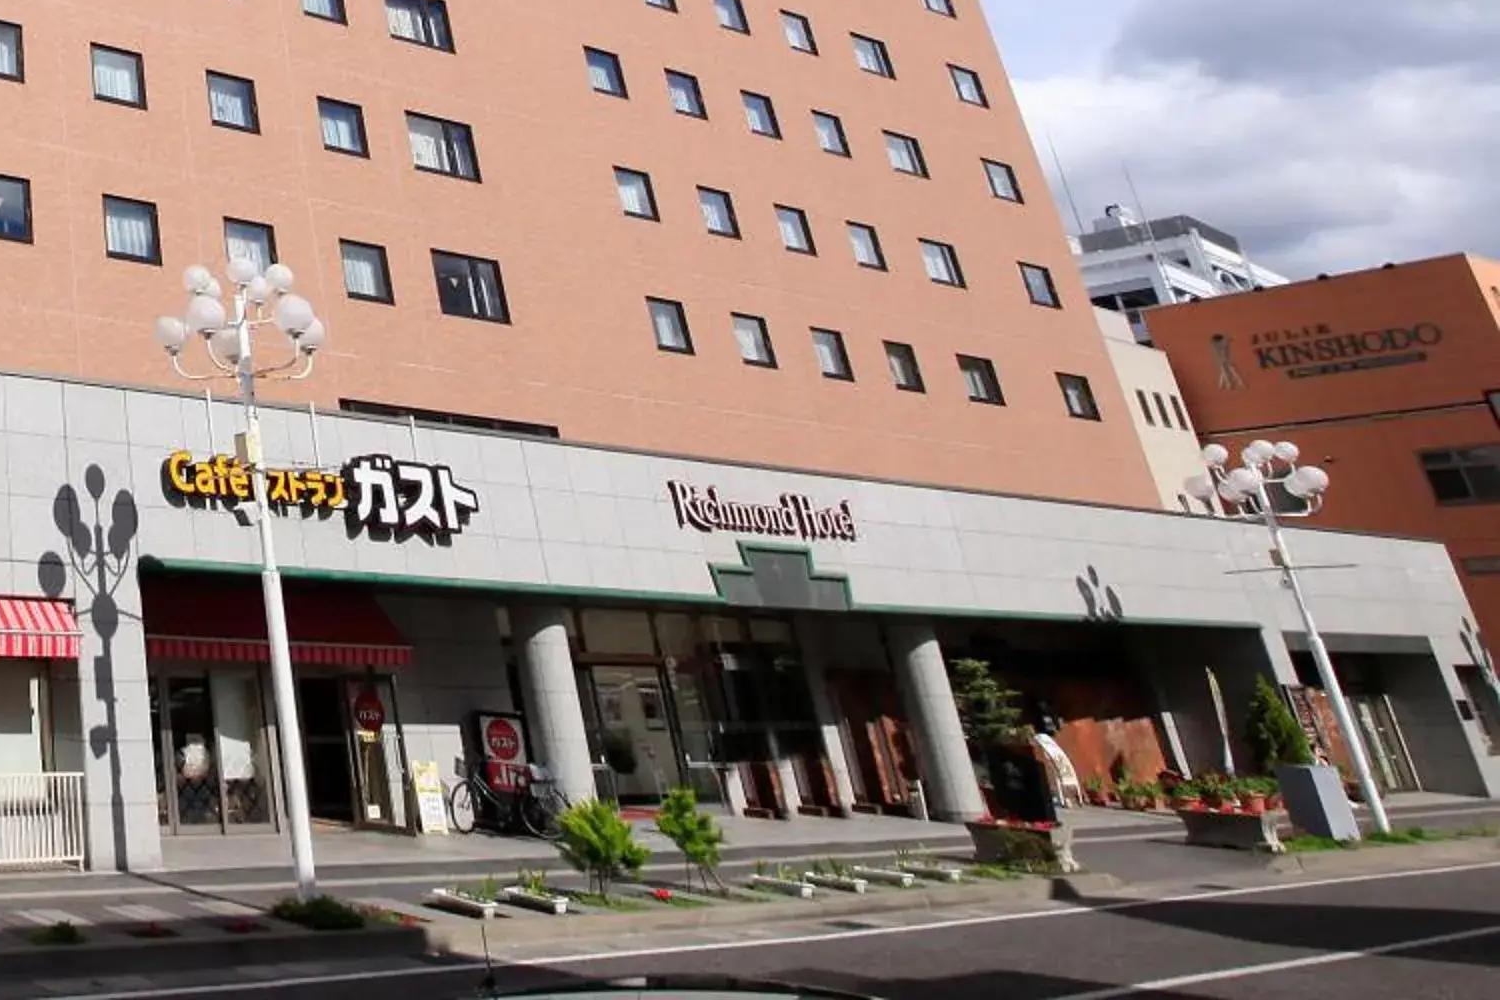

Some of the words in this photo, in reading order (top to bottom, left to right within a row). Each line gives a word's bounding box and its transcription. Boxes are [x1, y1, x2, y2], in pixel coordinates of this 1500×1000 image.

[1255, 322, 1443, 369] KINSHODO
[353, 458, 478, 531] ガスト
[668, 479, 799, 534] Richmond
[795, 495, 857, 542] Hotel
